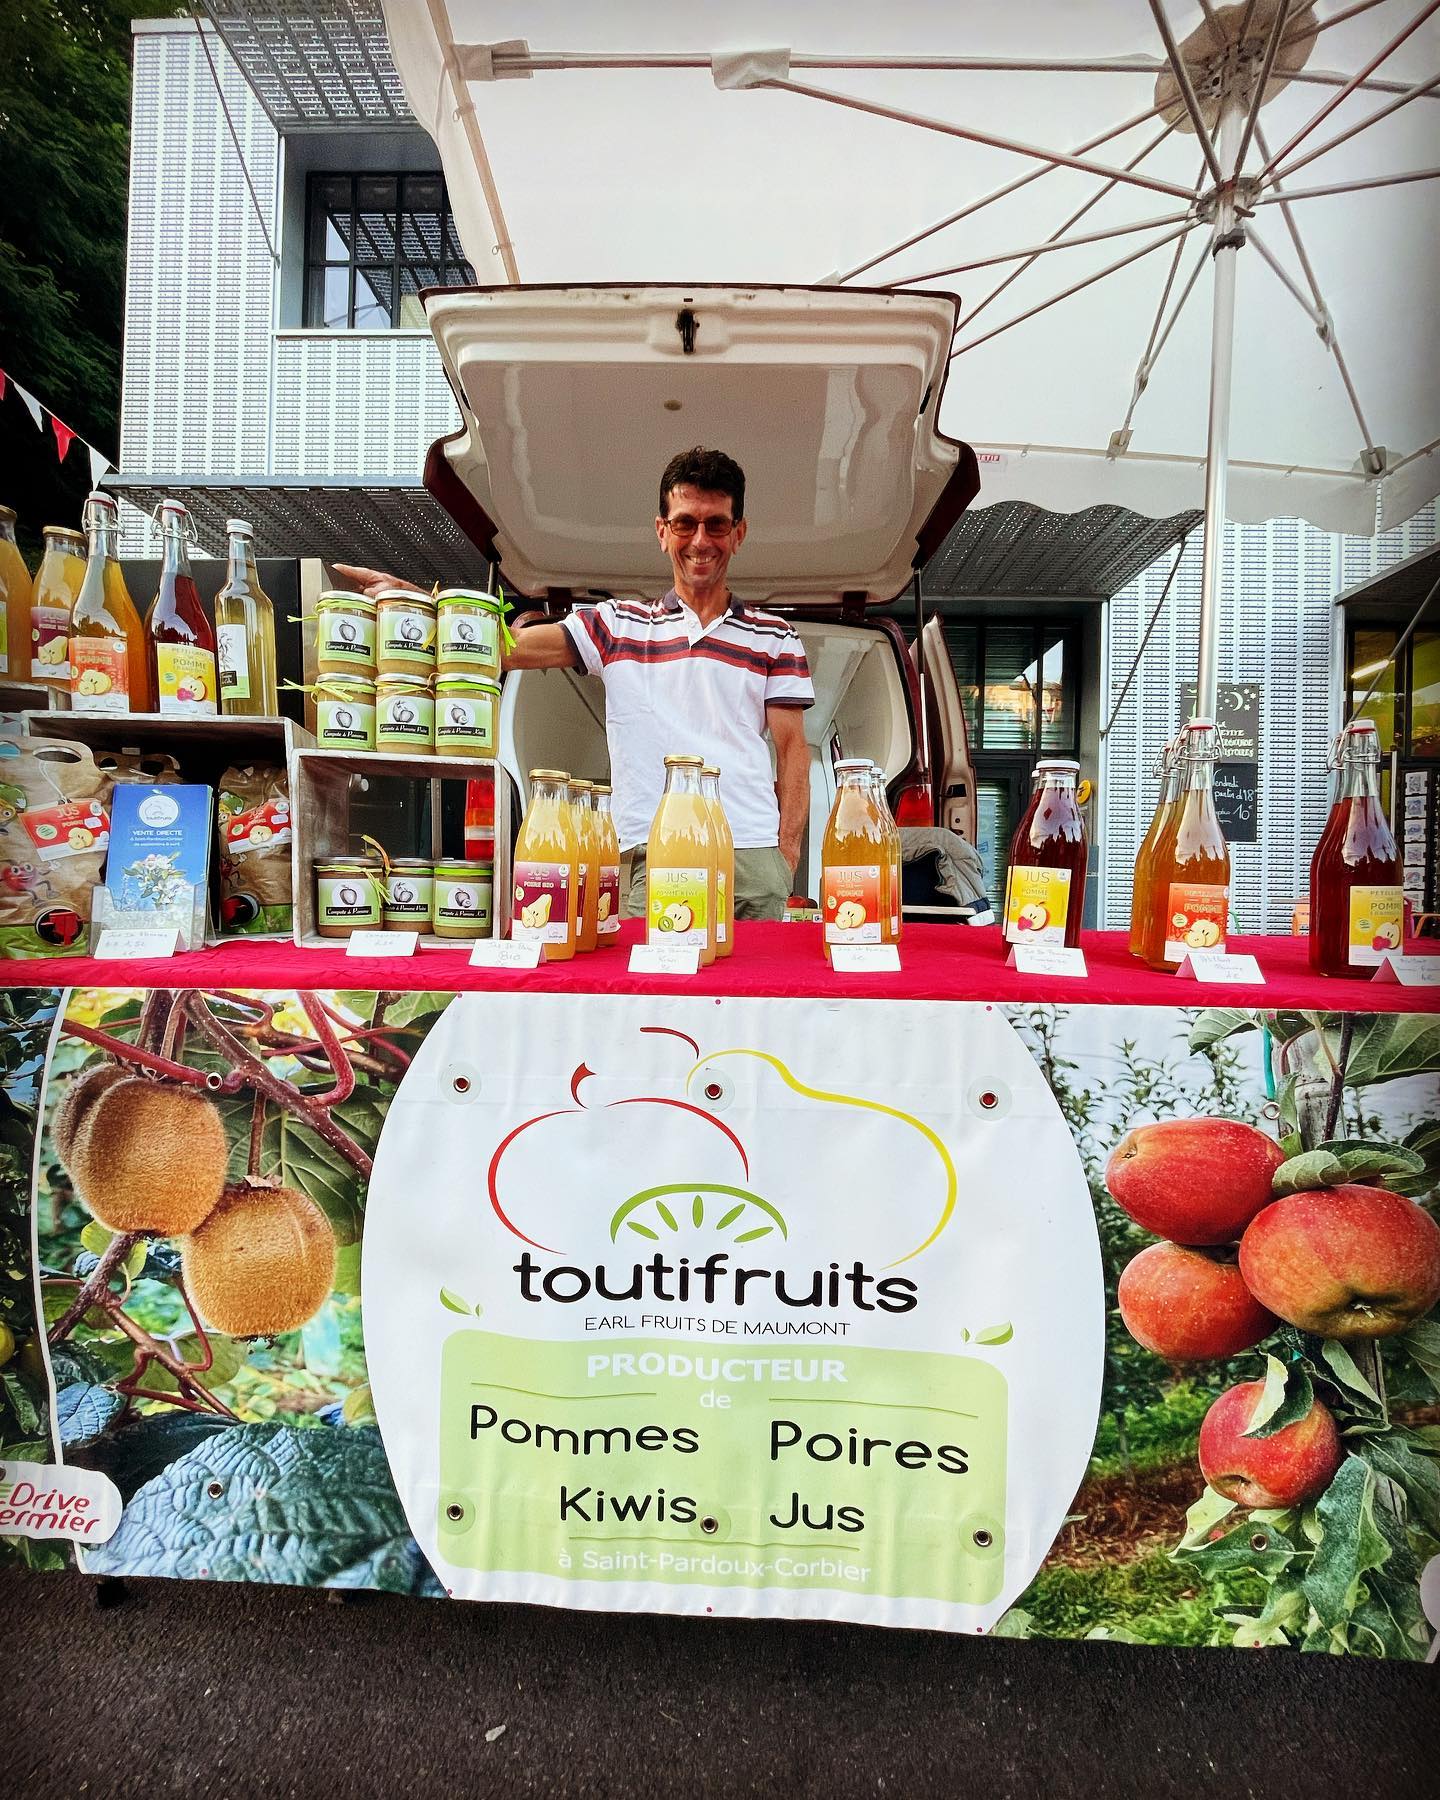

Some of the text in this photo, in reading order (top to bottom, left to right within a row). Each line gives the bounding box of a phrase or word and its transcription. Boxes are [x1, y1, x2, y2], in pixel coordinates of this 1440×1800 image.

[173, 658, 207, 670] POMME
[665, 872, 688, 883] JUS
[839, 871, 863, 881] JUS
[1024, 870, 1050, 884] JUS
[513, 1252, 919, 1314] toutifruits
[585, 1314, 851, 1336] EARL FRUITS DE MAUMONT
[587, 1352, 849, 1383] PRODUCTEUR
[699, 1389, 731, 1409] de
[470, 1404, 970, 1475] Pommes Poires
[9, 1482, 90, 1513] Drive
[559, 1485, 866, 1533] Kiwis Jus
[0, 1508, 102, 1534] ermier
[559, 1549, 872, 1584] à Saint-Pardoux-Corbier
